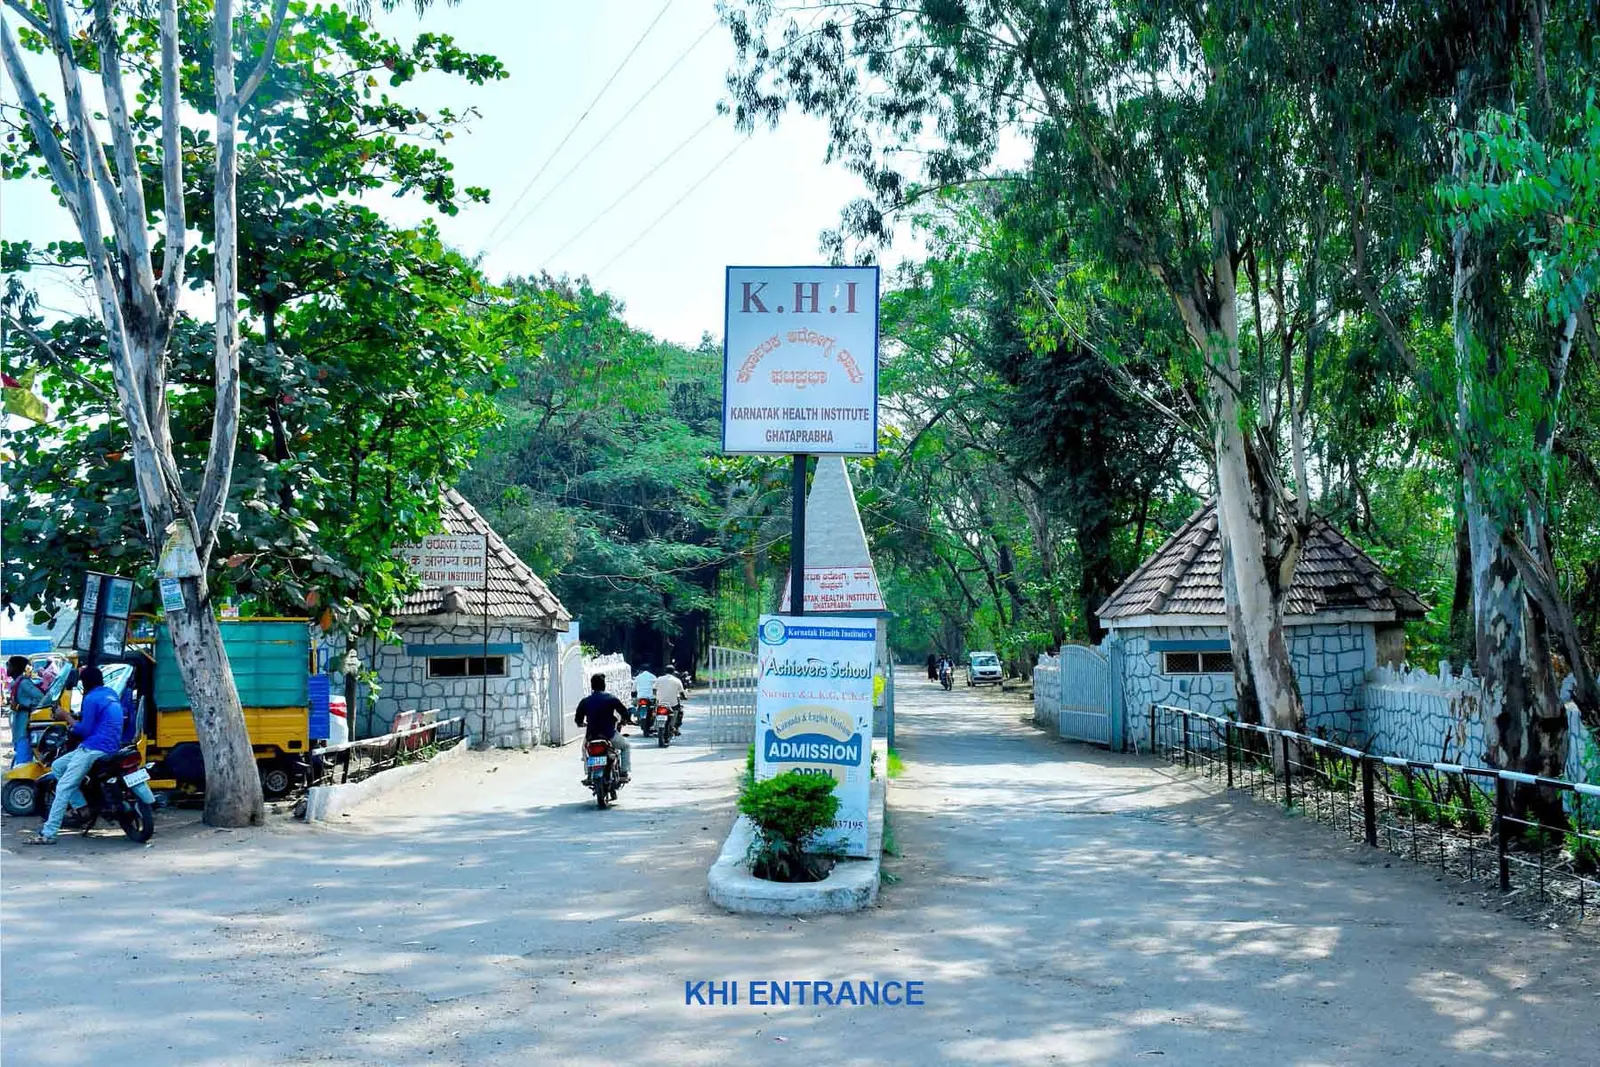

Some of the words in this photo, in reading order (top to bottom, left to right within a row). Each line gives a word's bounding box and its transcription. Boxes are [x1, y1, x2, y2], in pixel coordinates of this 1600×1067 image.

[731, 407, 780, 421] KARNATAK
[782, 407, 819, 421] HEALTH
[821, 408, 869, 421] INSTITUTE
[765, 429, 833, 443] GHATAPRABHA
[448, 571, 484, 581] INSTITUTE
[821, 594, 844, 602] HEALTH
[846, 593, 877, 601] INSTITUTE
[788, 628, 818, 637] Karnatak
[819, 629, 840, 638] Health
[766, 657, 828, 678] Achievers
[830, 660, 873, 680] School
[769, 742, 857, 761] ADMISSION
